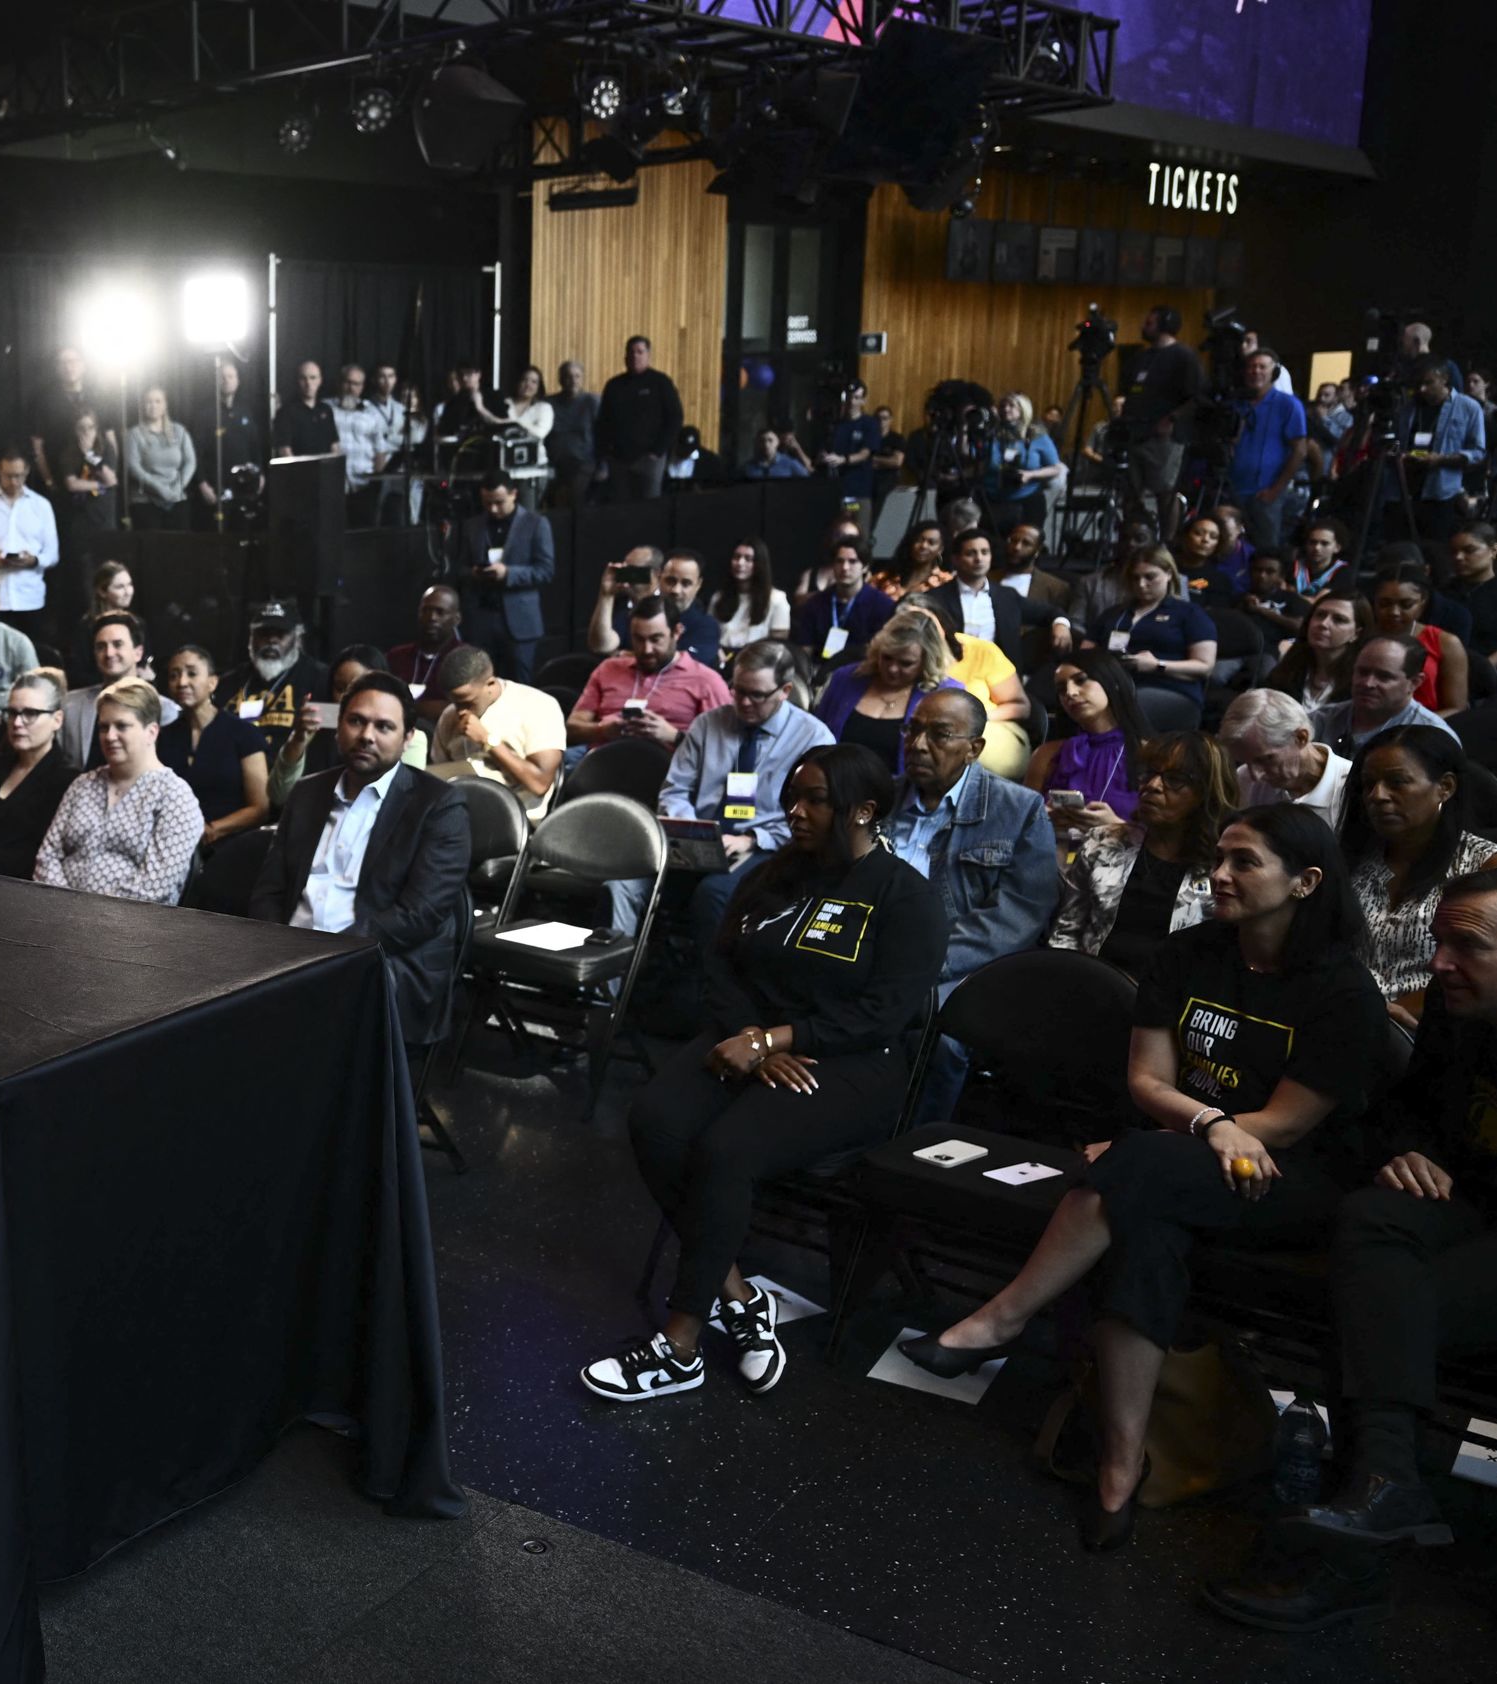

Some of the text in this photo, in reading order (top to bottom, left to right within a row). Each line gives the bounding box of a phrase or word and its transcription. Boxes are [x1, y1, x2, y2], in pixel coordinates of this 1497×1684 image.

[1149, 162, 1239, 215] TICKETS
[1190, 1008, 1239, 1040] BRING
[1187, 1030, 1215, 1057] OUR
